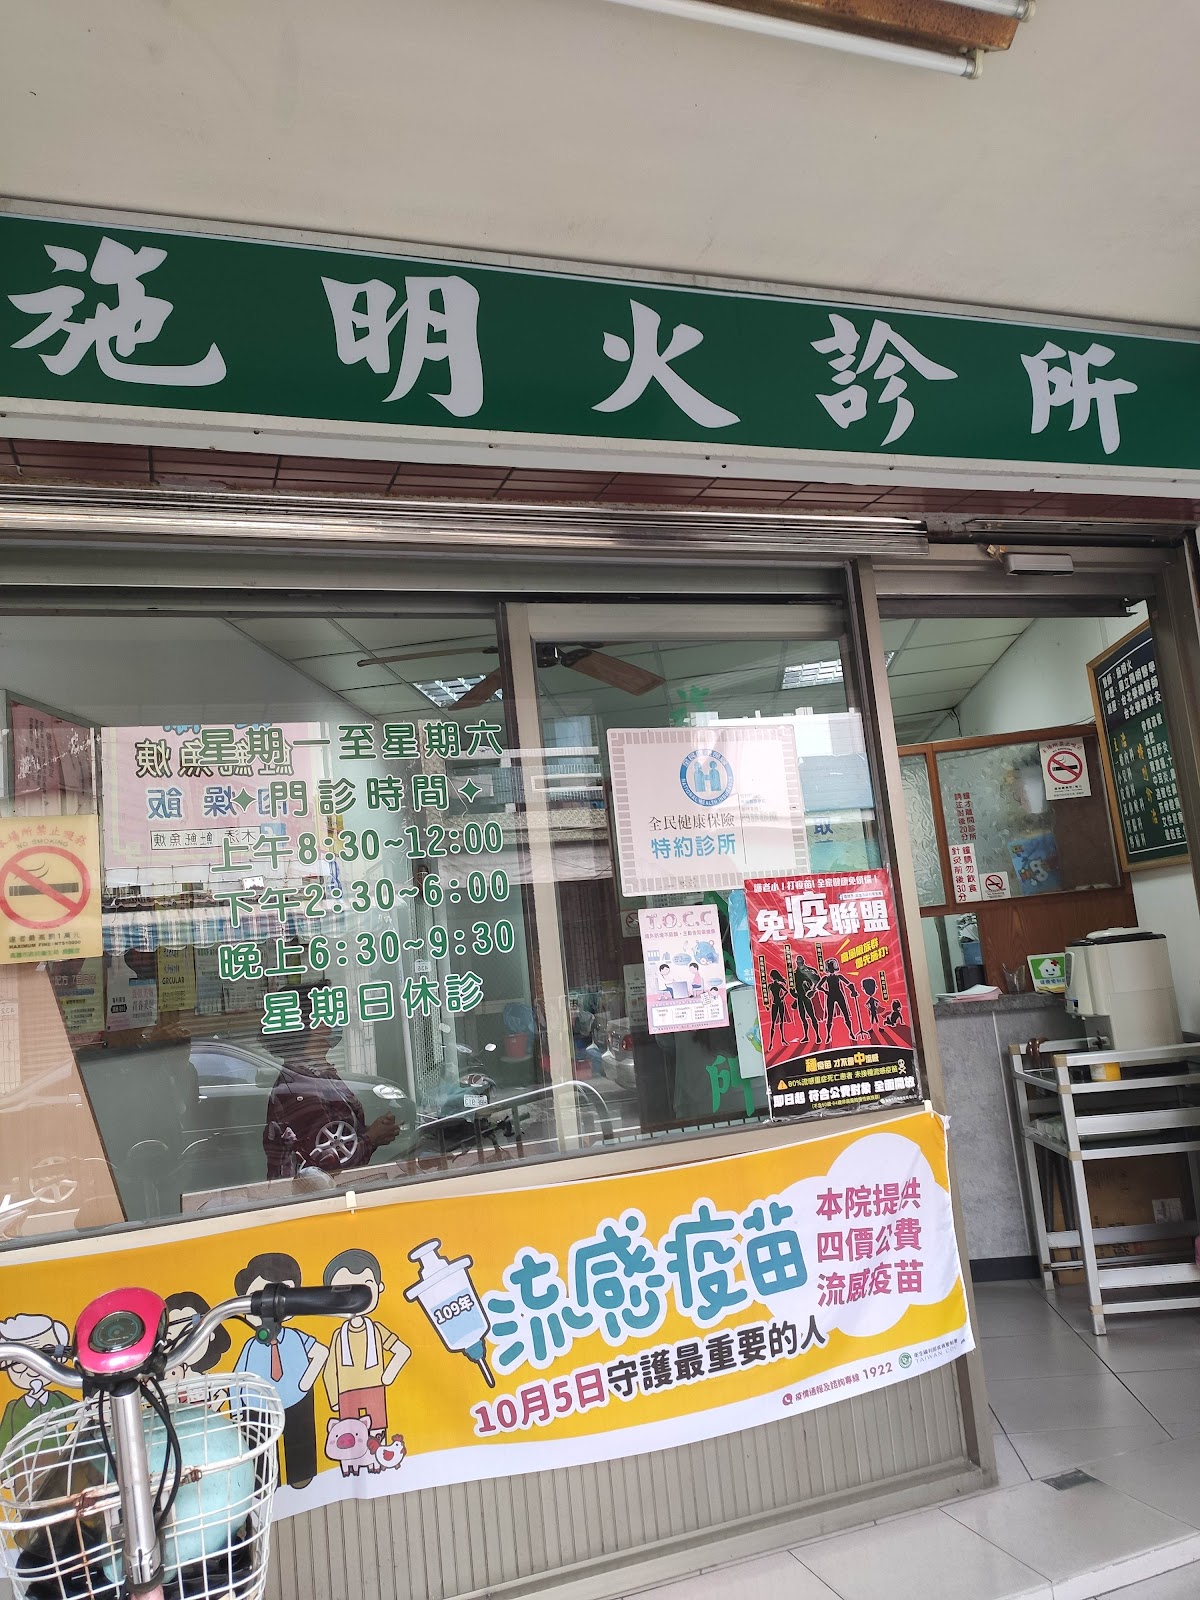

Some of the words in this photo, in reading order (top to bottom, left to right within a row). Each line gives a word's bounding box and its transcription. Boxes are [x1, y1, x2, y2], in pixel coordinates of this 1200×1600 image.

[8, 236, 1138, 454] 施明火診所
[199, 719, 504, 767] 星期一至星期六
[269, 773, 450, 820] 門診時間
[17, 841, 29, 849] NO
[31, 838, 69, 848] SMOKING
[647, 813, 736, 832] 全民健康保險
[210, 820, 504, 874] 上午8:30~12:00
[650, 833, 737, 860] 特約診所
[951, 846, 967, 902] 針灸前後30分
[213, 869, 510, 928] 下午2:30~6:00
[755, 891, 891, 943] 免疫聯盟
[9, 932, 81, 943] 違者最高罰1萬元
[218, 919, 515, 981] 晚上6:30~9:30
[840, 937, 880, 963] 高風險族群
[260, 971, 484, 1035] 星期日休診
[773, 1091, 806, 1108] 即日起
[808, 1082, 872, 1102] 符合公費對象
[874, 1075, 916, 1093] 全面開放
[815, 1177, 922, 1223] 本院提供
[816, 1217, 922, 1264] 四價公費
[487, 1202, 809, 1367] 流感疫苗
[816, 1259, 924, 1310] 流感疫苗
[433, 1294, 474, 1327] 109年
[474, 1313, 828, 1434] 10月5日守護最重要的人
[862, 1361, 893, 1381] 1922
[915, 1351, 943, 1364] TAIWAN
